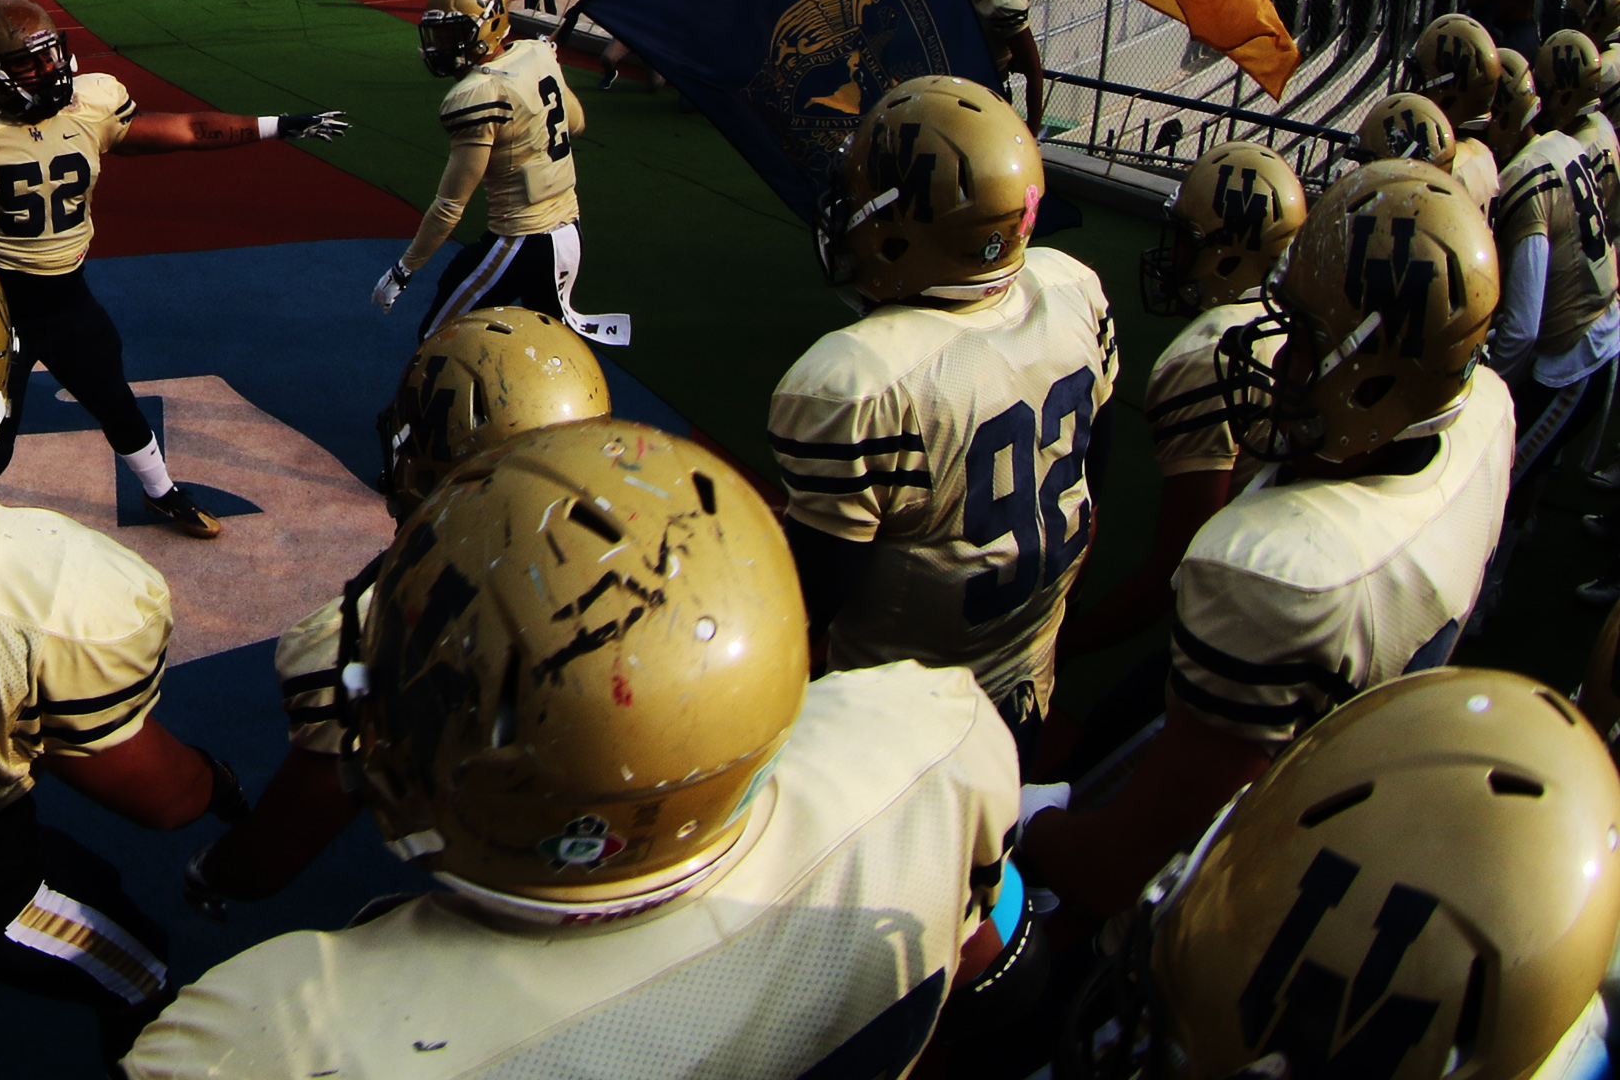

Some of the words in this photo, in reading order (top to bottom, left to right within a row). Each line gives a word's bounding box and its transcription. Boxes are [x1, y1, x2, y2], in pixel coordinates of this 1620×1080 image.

[538, 75, 571, 162] 2
[1345, 216, 1435, 359] UM
[962, 365, 1096, 626] 92
